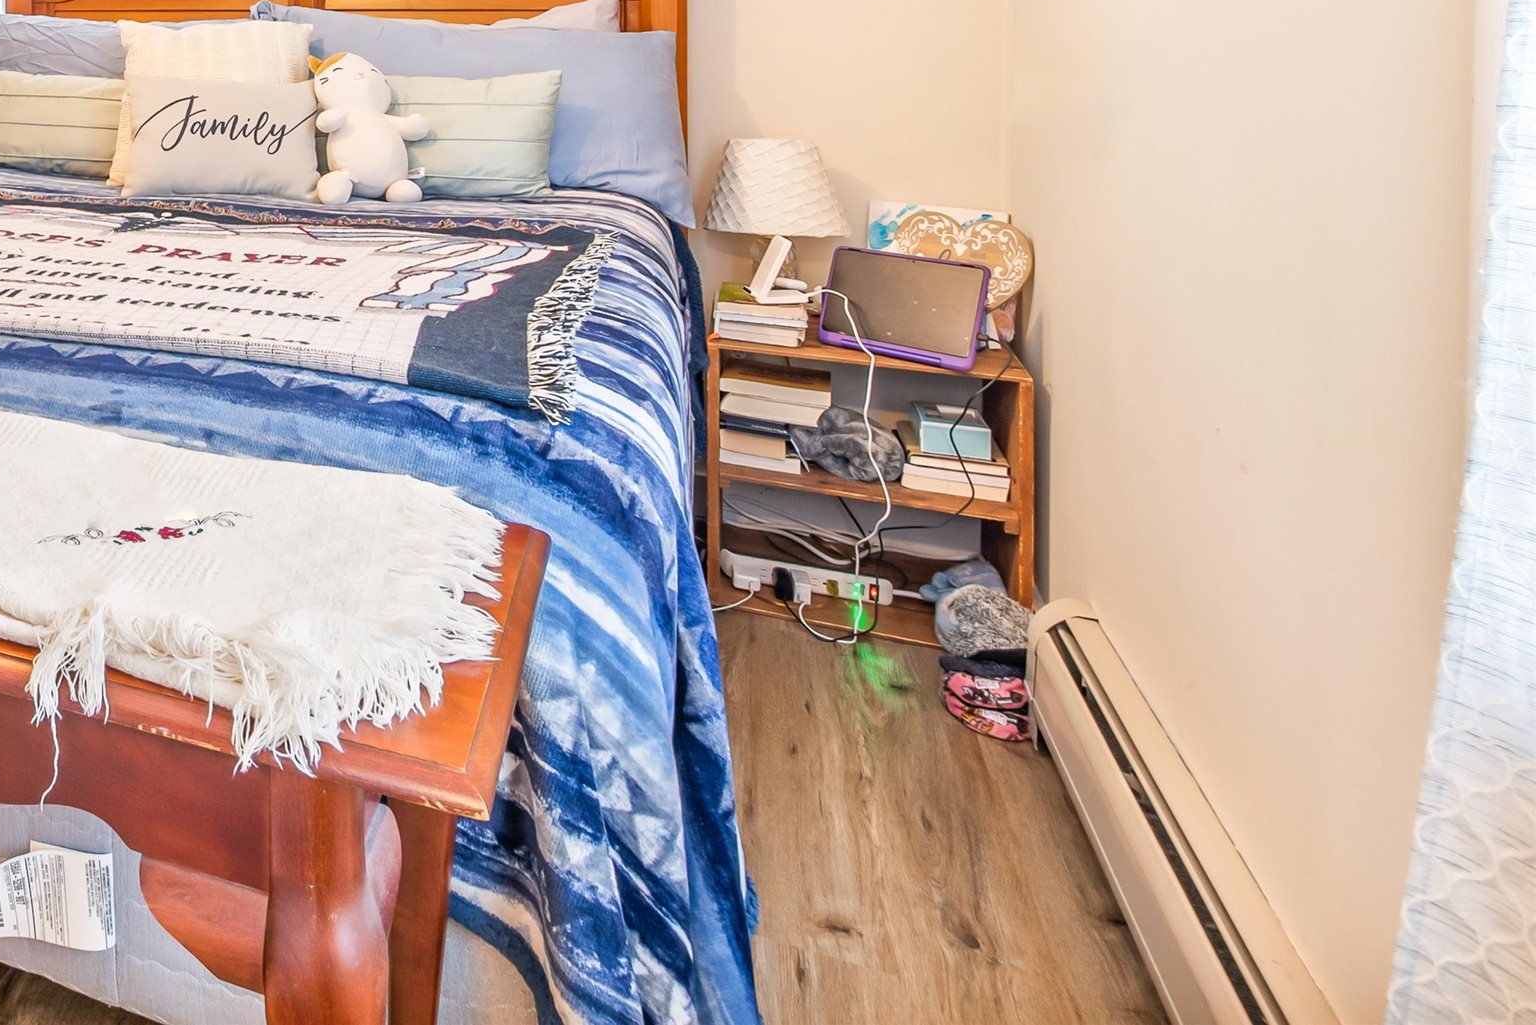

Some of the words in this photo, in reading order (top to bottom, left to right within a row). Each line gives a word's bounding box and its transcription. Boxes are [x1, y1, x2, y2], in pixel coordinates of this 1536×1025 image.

[131, 94, 321, 155] Family
[126, 243, 348, 267] PRAYER
[28, 291, 110, 304] and
